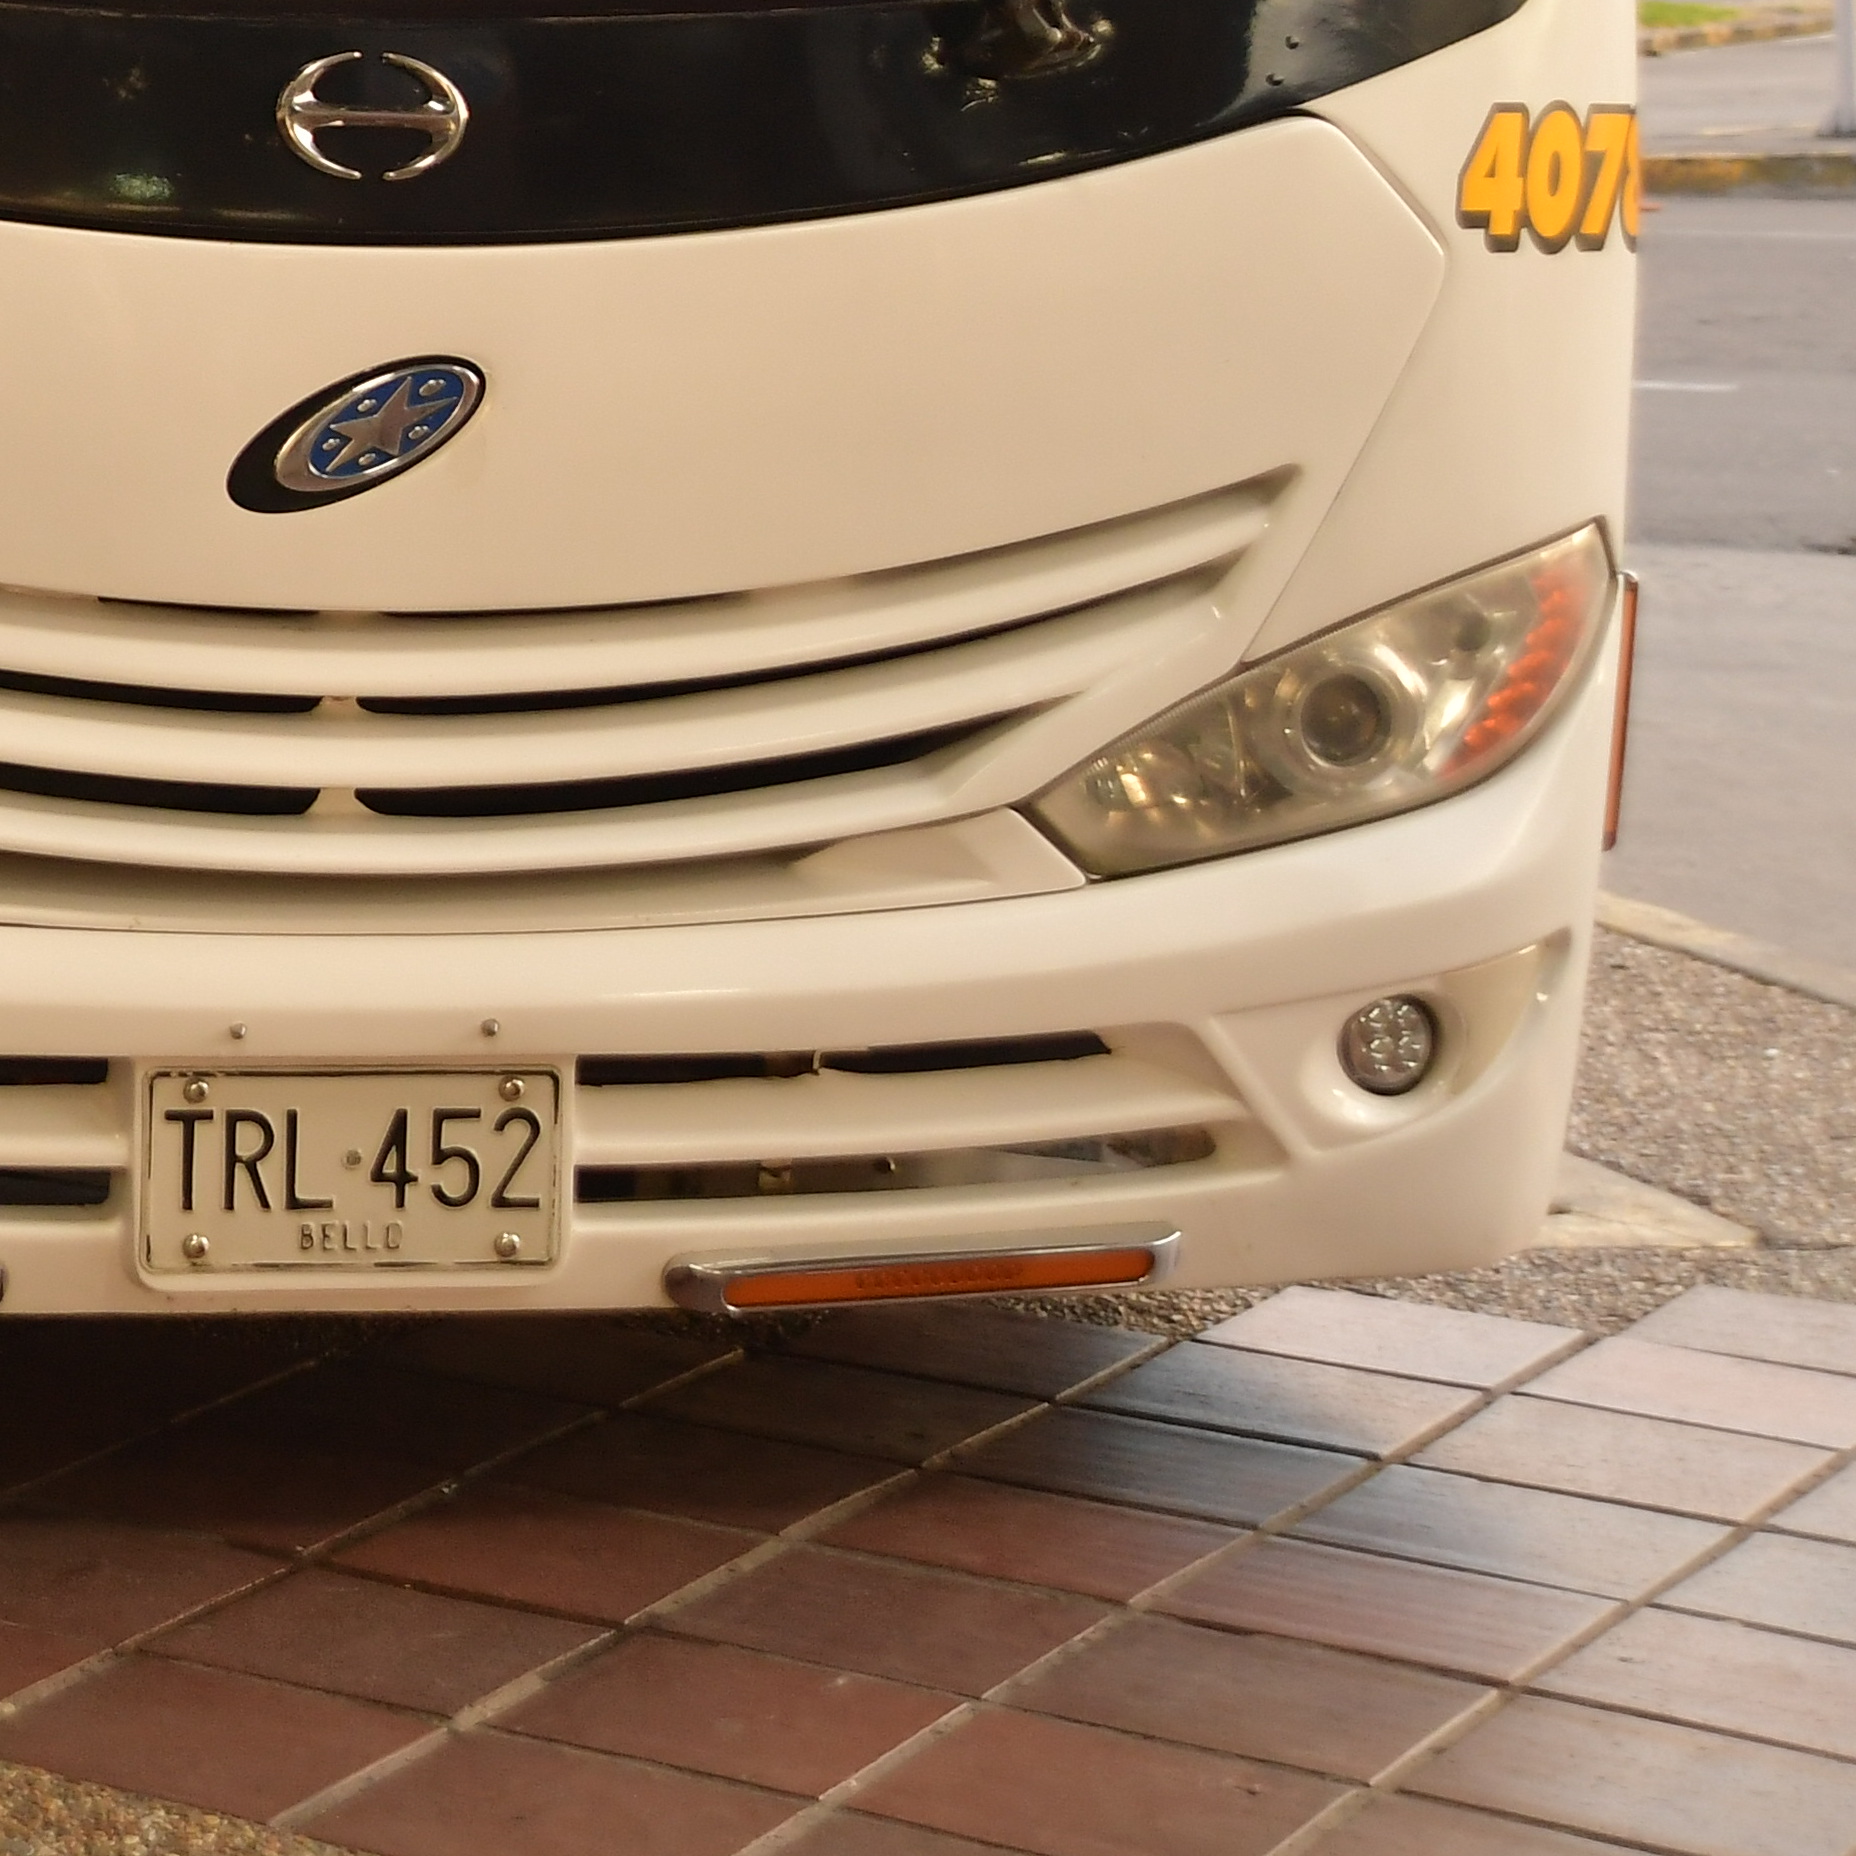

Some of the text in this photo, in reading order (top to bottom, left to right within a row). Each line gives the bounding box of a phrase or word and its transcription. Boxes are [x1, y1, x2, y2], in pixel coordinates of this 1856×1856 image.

[164, 1106, 542, 1210] TRL 452
[299, 1220, 403, 1251] BELLO
